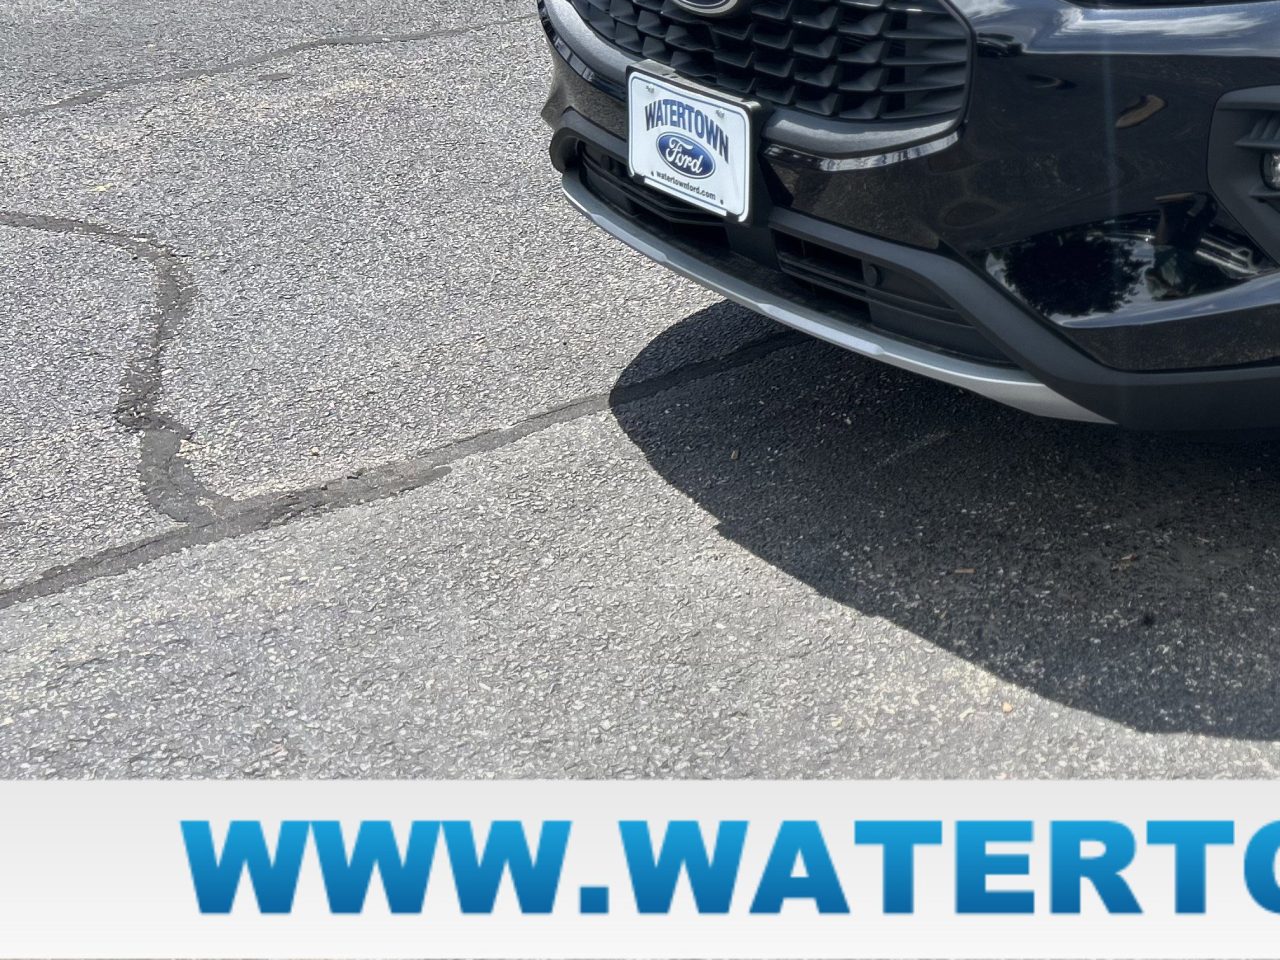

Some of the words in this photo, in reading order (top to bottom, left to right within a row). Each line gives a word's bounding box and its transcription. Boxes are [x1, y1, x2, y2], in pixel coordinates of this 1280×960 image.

[645, 99, 729, 164] WATERTOWN
[665, 137, 704, 174] Ford
[656, 171, 717, 201] watertownford.com
